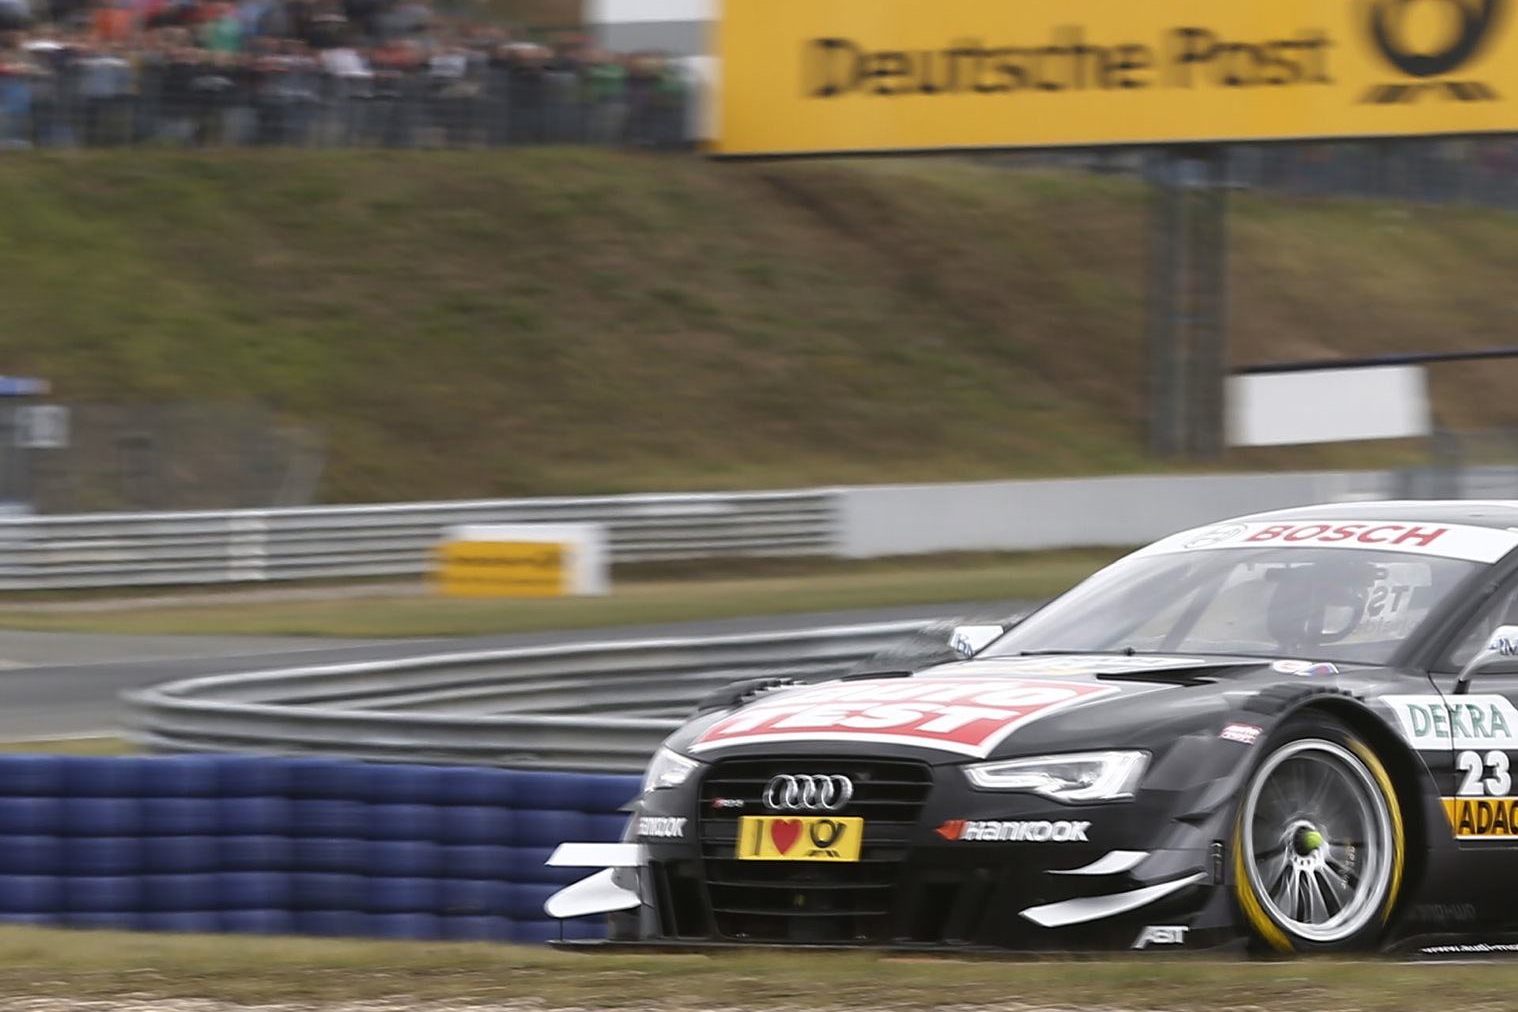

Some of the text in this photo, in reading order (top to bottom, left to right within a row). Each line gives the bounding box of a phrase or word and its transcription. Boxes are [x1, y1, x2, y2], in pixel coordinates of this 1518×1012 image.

[804, 24, 1336, 99] Deutsche Post
[1243, 524, 1450, 547] BOSCH
[717, 702, 1021, 734] TEST
[1406, 703, 1512, 738] DEKRA
[1456, 750, 1511, 796] 23
[1131, 926, 1189, 949] ABT
